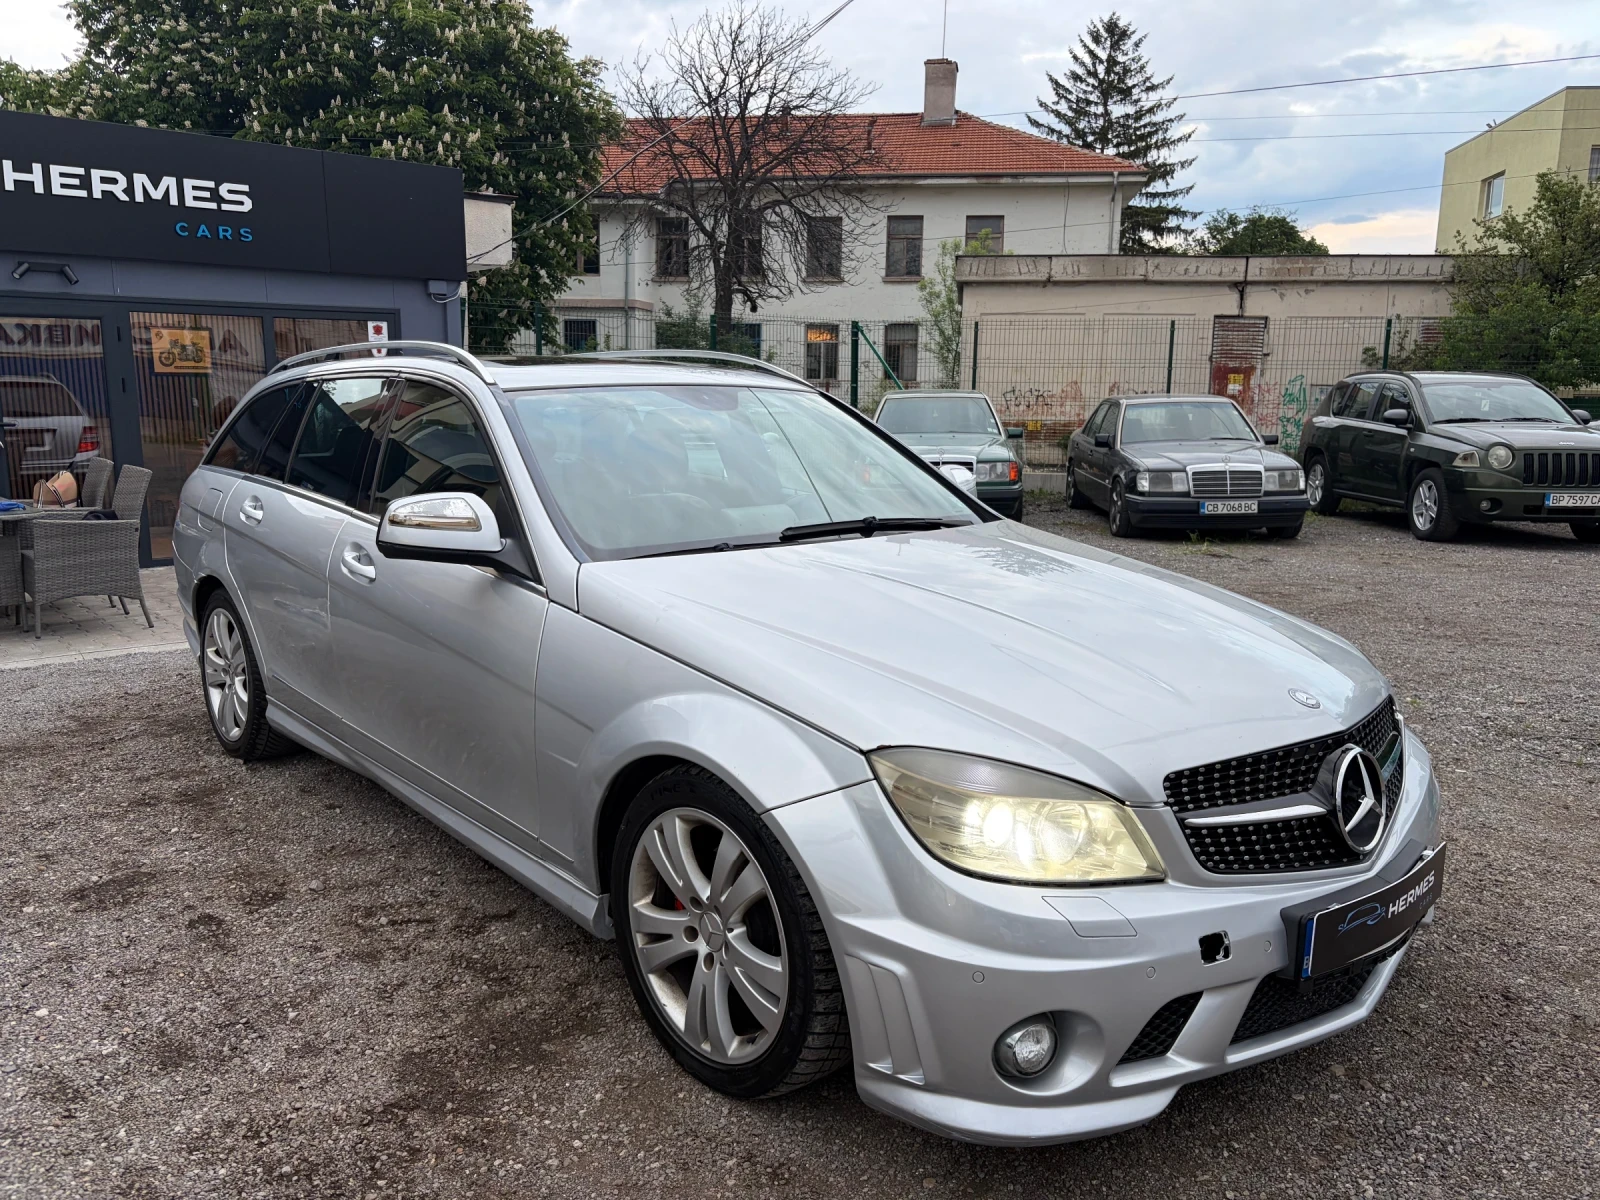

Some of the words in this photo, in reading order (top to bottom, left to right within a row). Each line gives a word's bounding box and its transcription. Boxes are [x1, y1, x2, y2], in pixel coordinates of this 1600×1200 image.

[2, 159, 252, 213] HERMES
[175, 222, 254, 242] CARS
[1206, 503, 1219, 513] CB
[1220, 503, 1243, 512] 7068
[1244, 502, 1256, 512] BC
[1552, 495, 1565, 505] BP
[1566, 495, 1590, 505] 7597
[1388, 870, 1435, 919] HERMES
[1303, 955, 1310, 969] B
